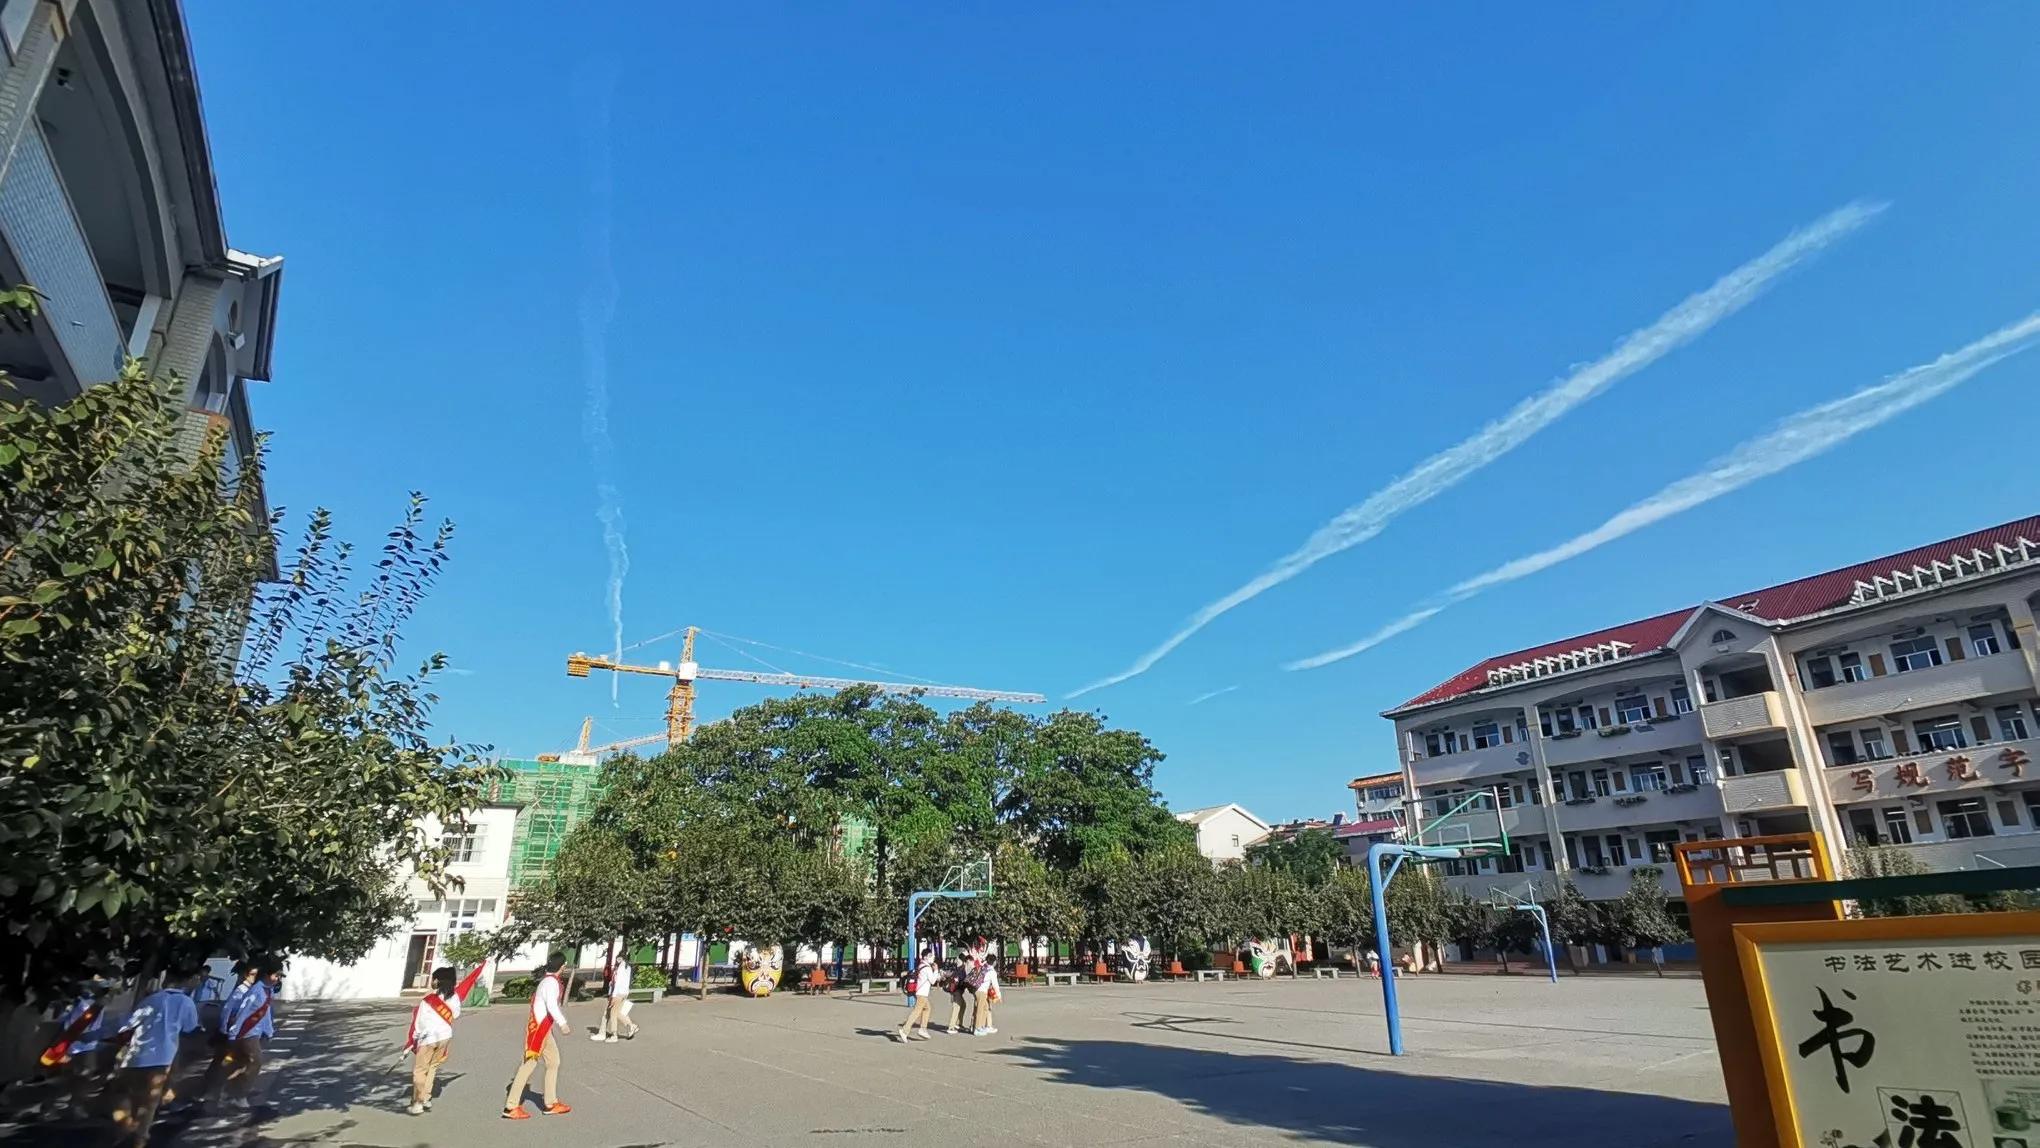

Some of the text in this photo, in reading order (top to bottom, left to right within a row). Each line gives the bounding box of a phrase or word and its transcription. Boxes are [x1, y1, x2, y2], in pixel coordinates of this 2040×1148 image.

[1850, 748, 2031, 792] 写规范字
[1824, 949, 2040, 973] 书法艺术进校园
